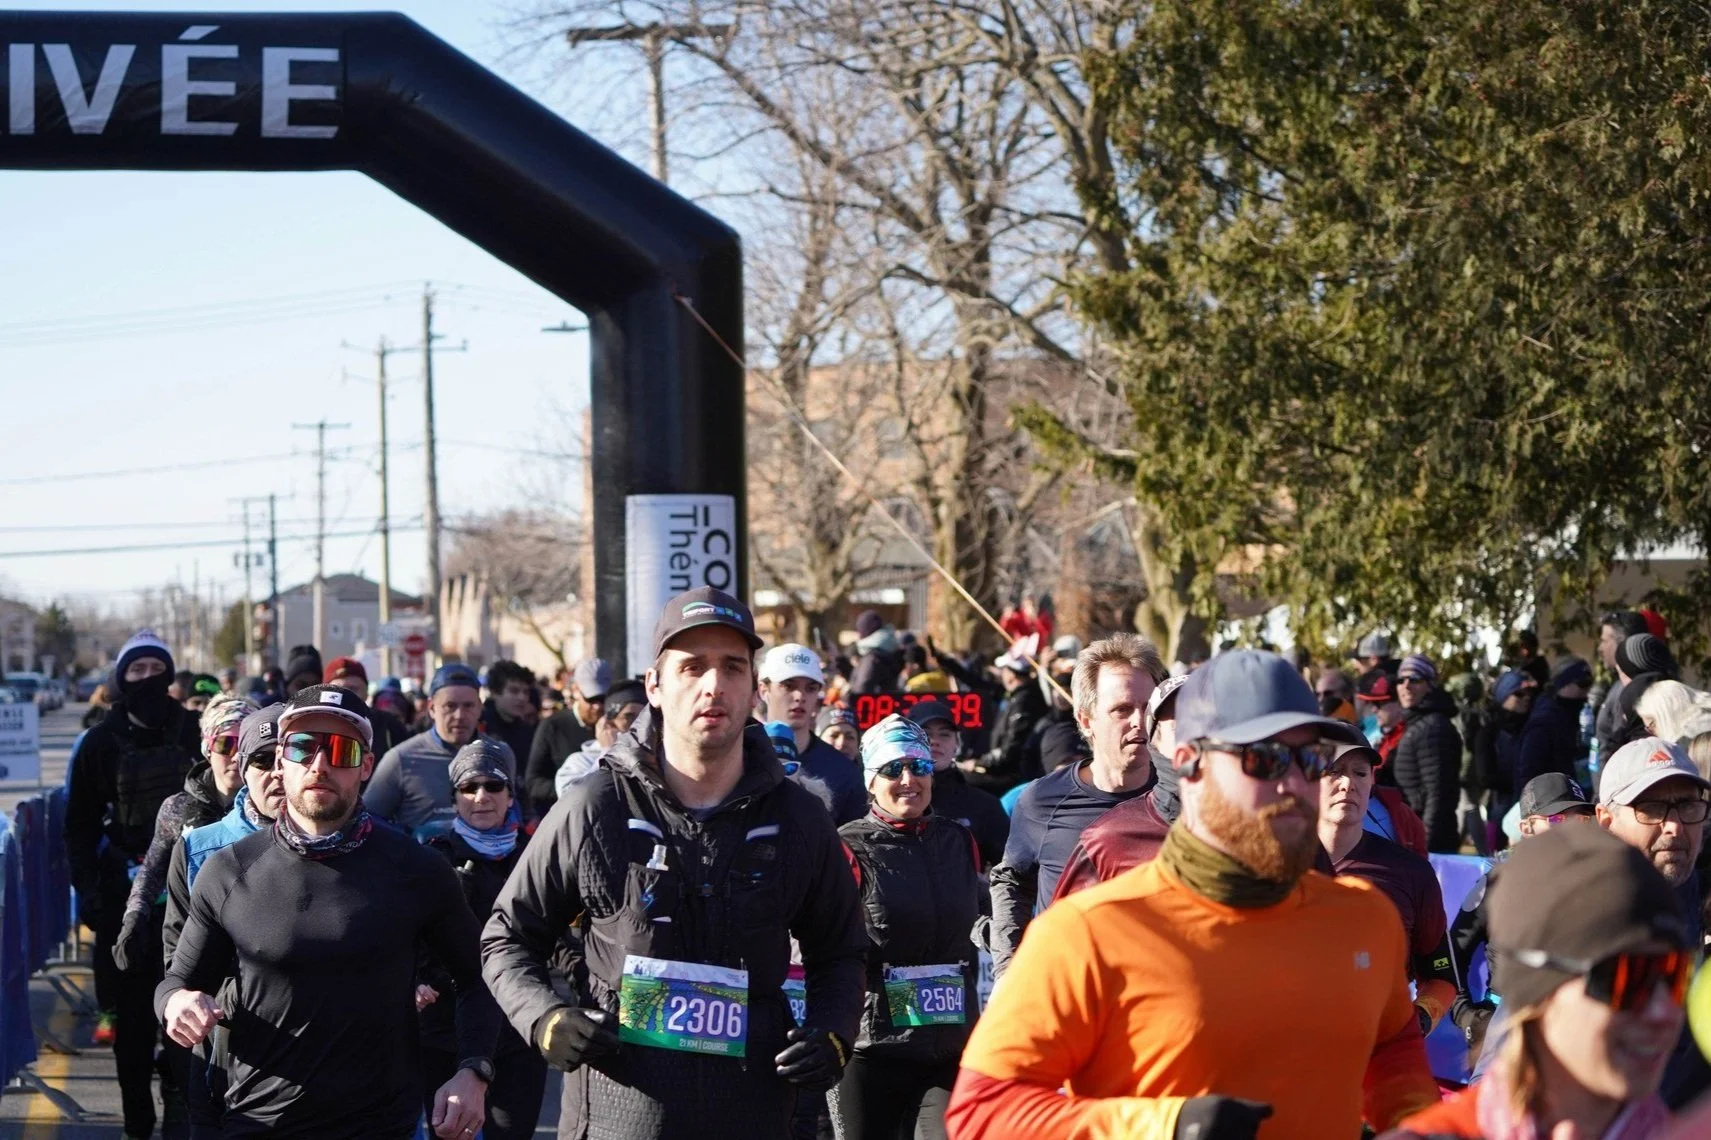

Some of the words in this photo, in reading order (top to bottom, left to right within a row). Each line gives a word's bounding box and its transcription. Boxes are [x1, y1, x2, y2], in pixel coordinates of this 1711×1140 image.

[784, 653, 810, 664] ciele
[921, 987, 962, 1012] 2564
[667, 995, 742, 1037] 2306
[702, 1041, 728, 1053] COURSE
